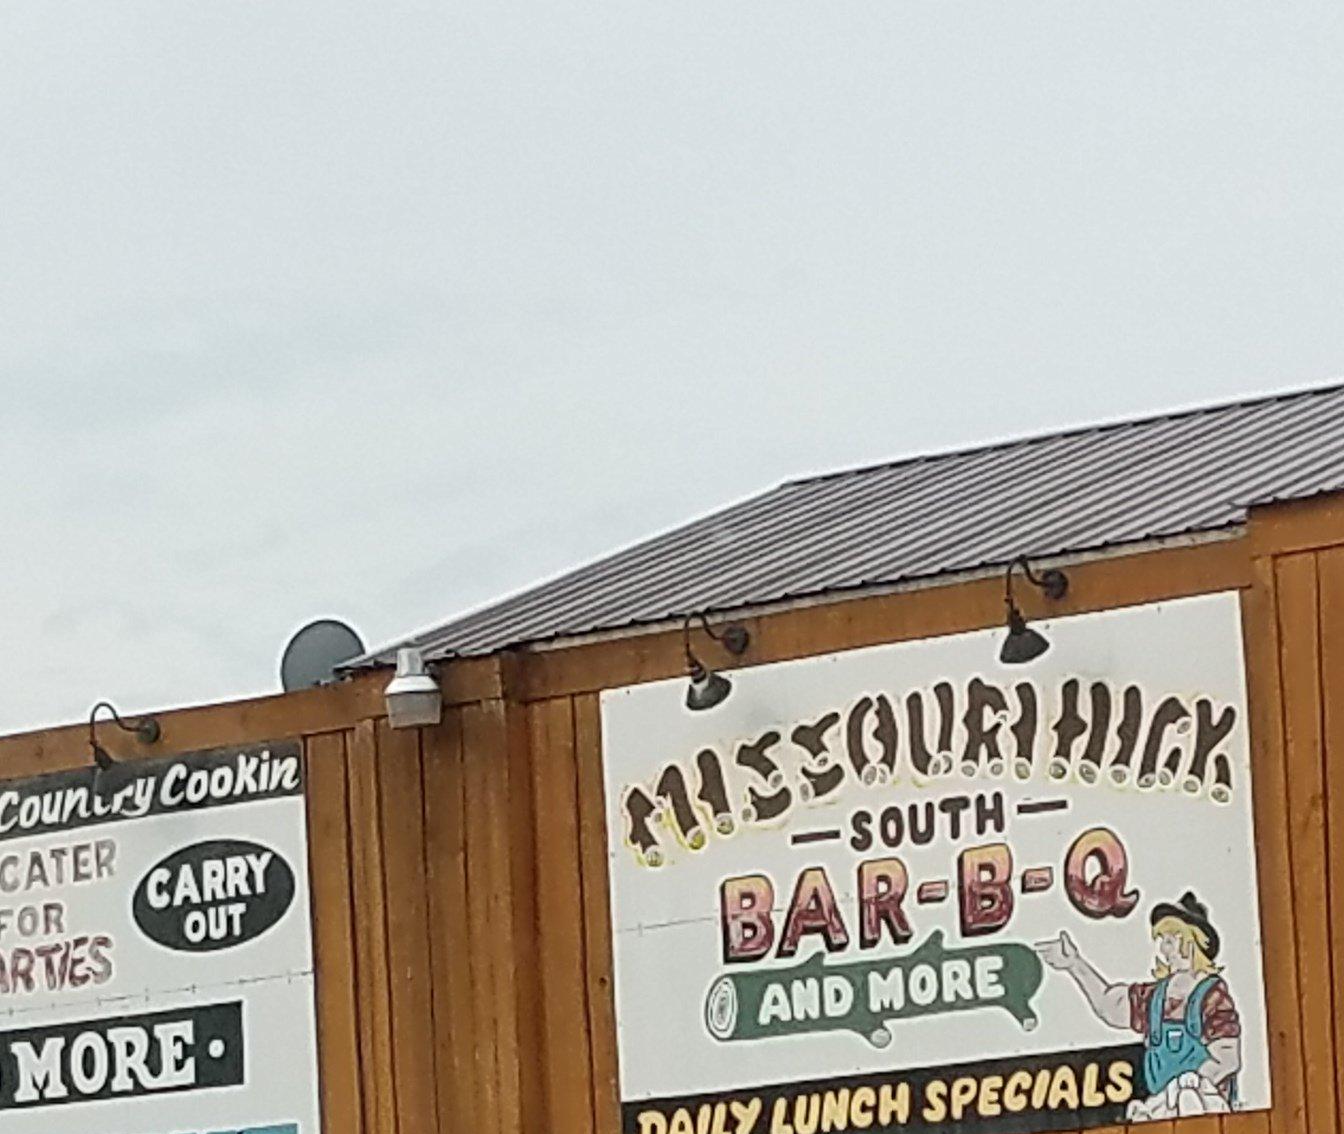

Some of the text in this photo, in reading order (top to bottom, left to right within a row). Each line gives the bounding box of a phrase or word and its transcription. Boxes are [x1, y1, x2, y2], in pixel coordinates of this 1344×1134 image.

[160, 751, 300, 807] Cookin
[626, 677, 1237, 867] MISSOURI HICK
[849, 790, 1006, 852] SOUTH
[147, 852, 272, 910] CARRY
[720, 828, 1140, 964] BAR-B-Q
[184, 902, 246, 943] OUT
[757, 955, 1005, 1025] AND MORE
[9, 1020, 195, 1102] MORE
[922, 1061, 1132, 1124] SPECIALS
